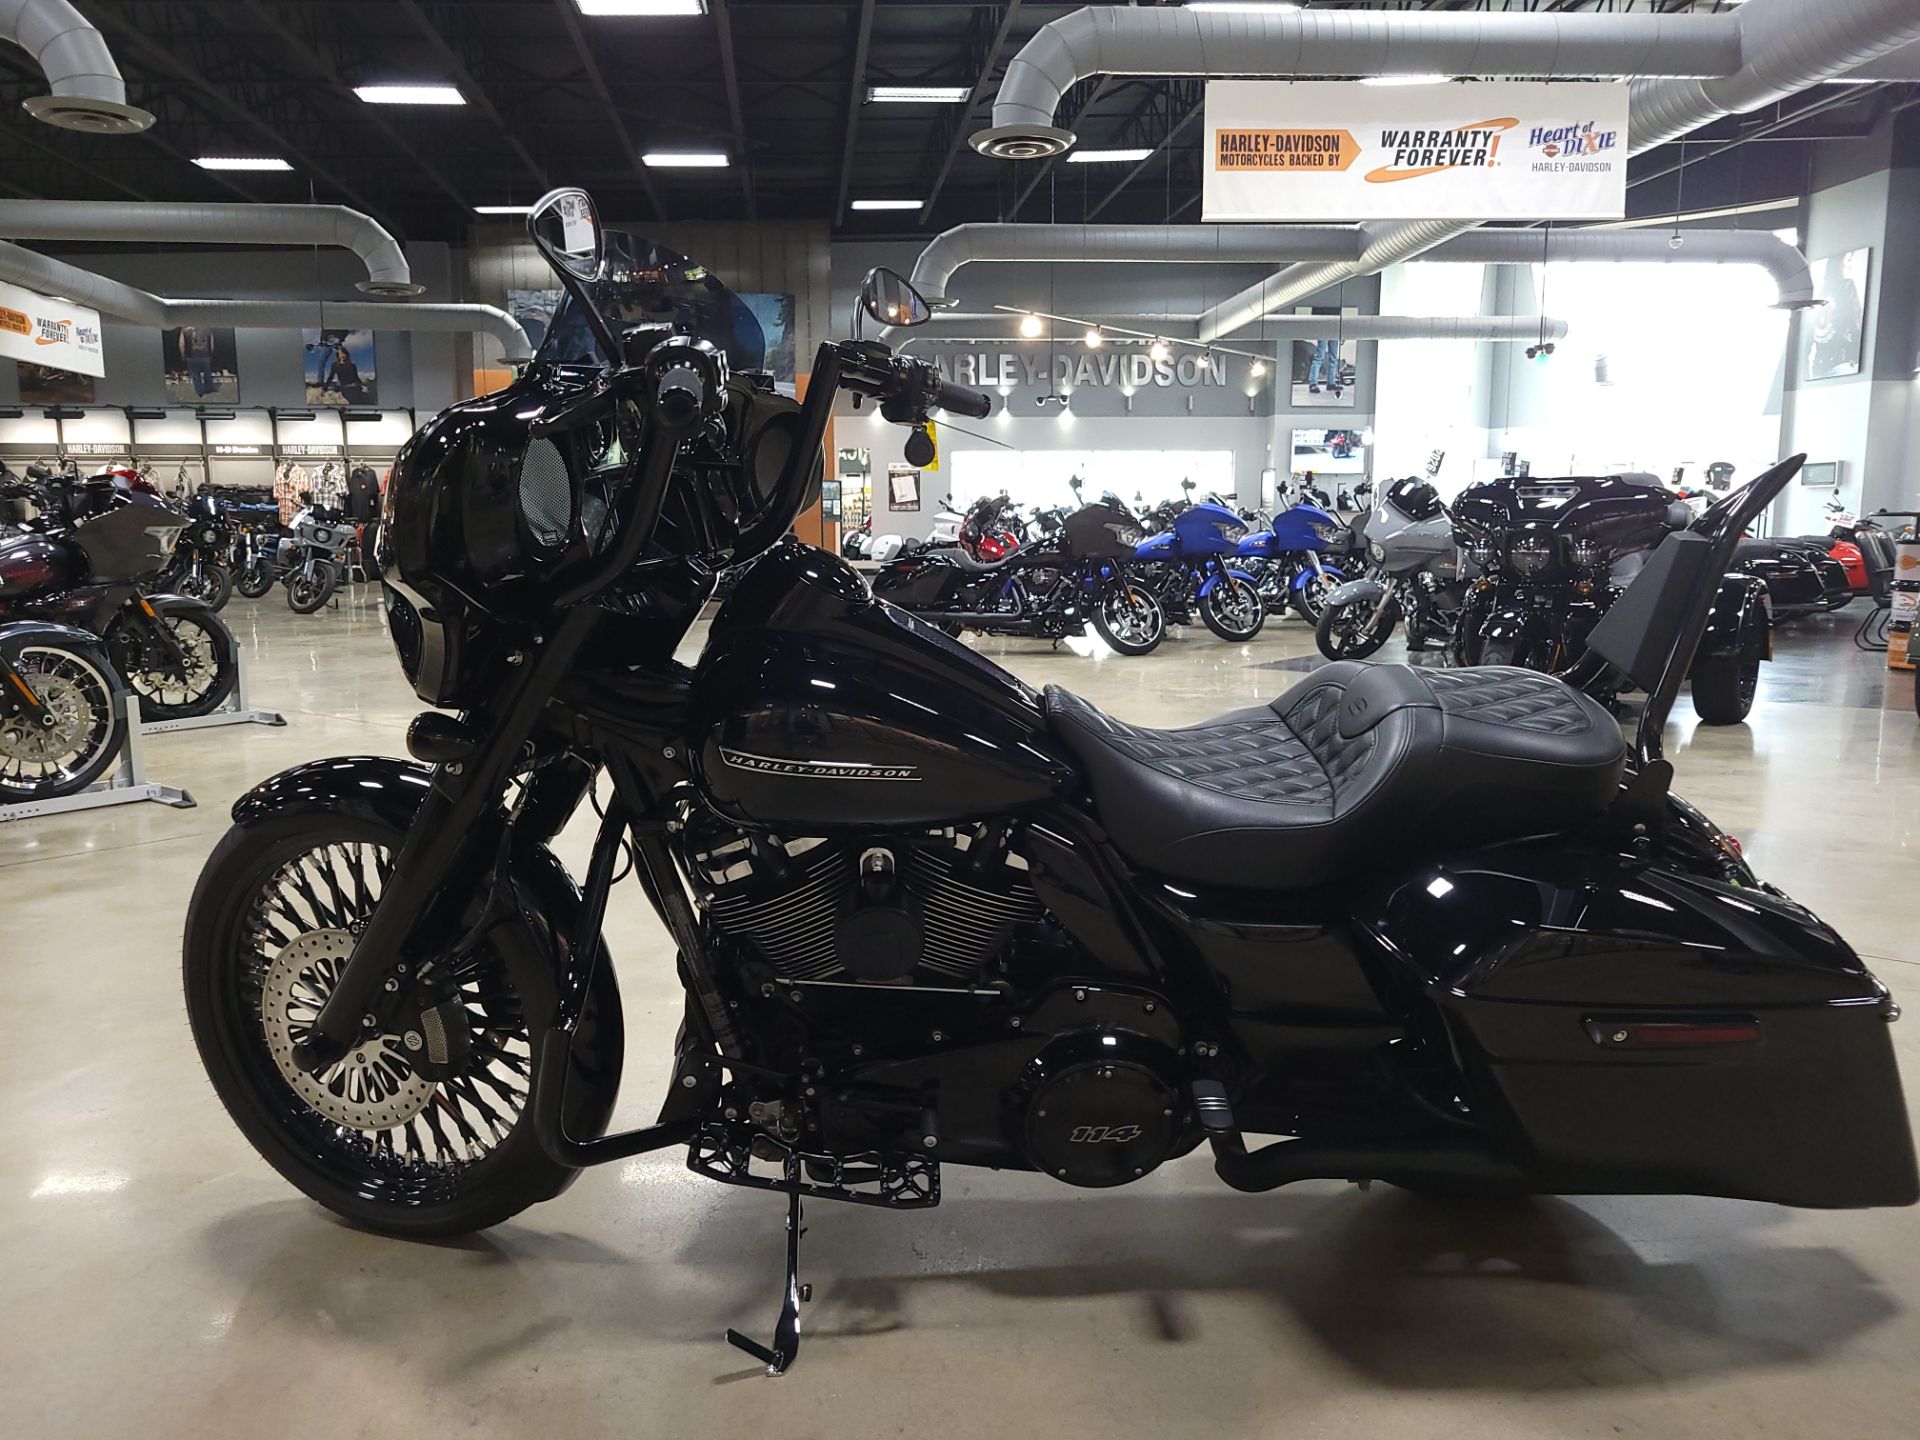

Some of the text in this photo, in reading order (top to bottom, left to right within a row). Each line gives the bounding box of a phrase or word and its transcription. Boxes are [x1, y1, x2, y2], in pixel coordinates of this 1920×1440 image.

[1220, 134, 1340, 152] HARLEY-DAVIDSON
[1381, 130, 1493, 148] WARRANTY
[1528, 121, 1595, 148] Heart of
[1562, 131, 1616, 157] DIXIE
[1220, 154, 1340, 166] MOTORCYCLES BACKED BY
[1532, 162, 1611, 172] HARLEY-DAVIDSON
[932, 353, 1227, 387] ARLEY-DAVIDSON
[67, 444, 125, 454] HARLEY-DAVIDSON
[281, 445, 338, 455] HARLEY-DAVIDSON
[730, 755, 912, 777] HARLEY-DAVIDSON
[1069, 1125, 1142, 1143] 114
